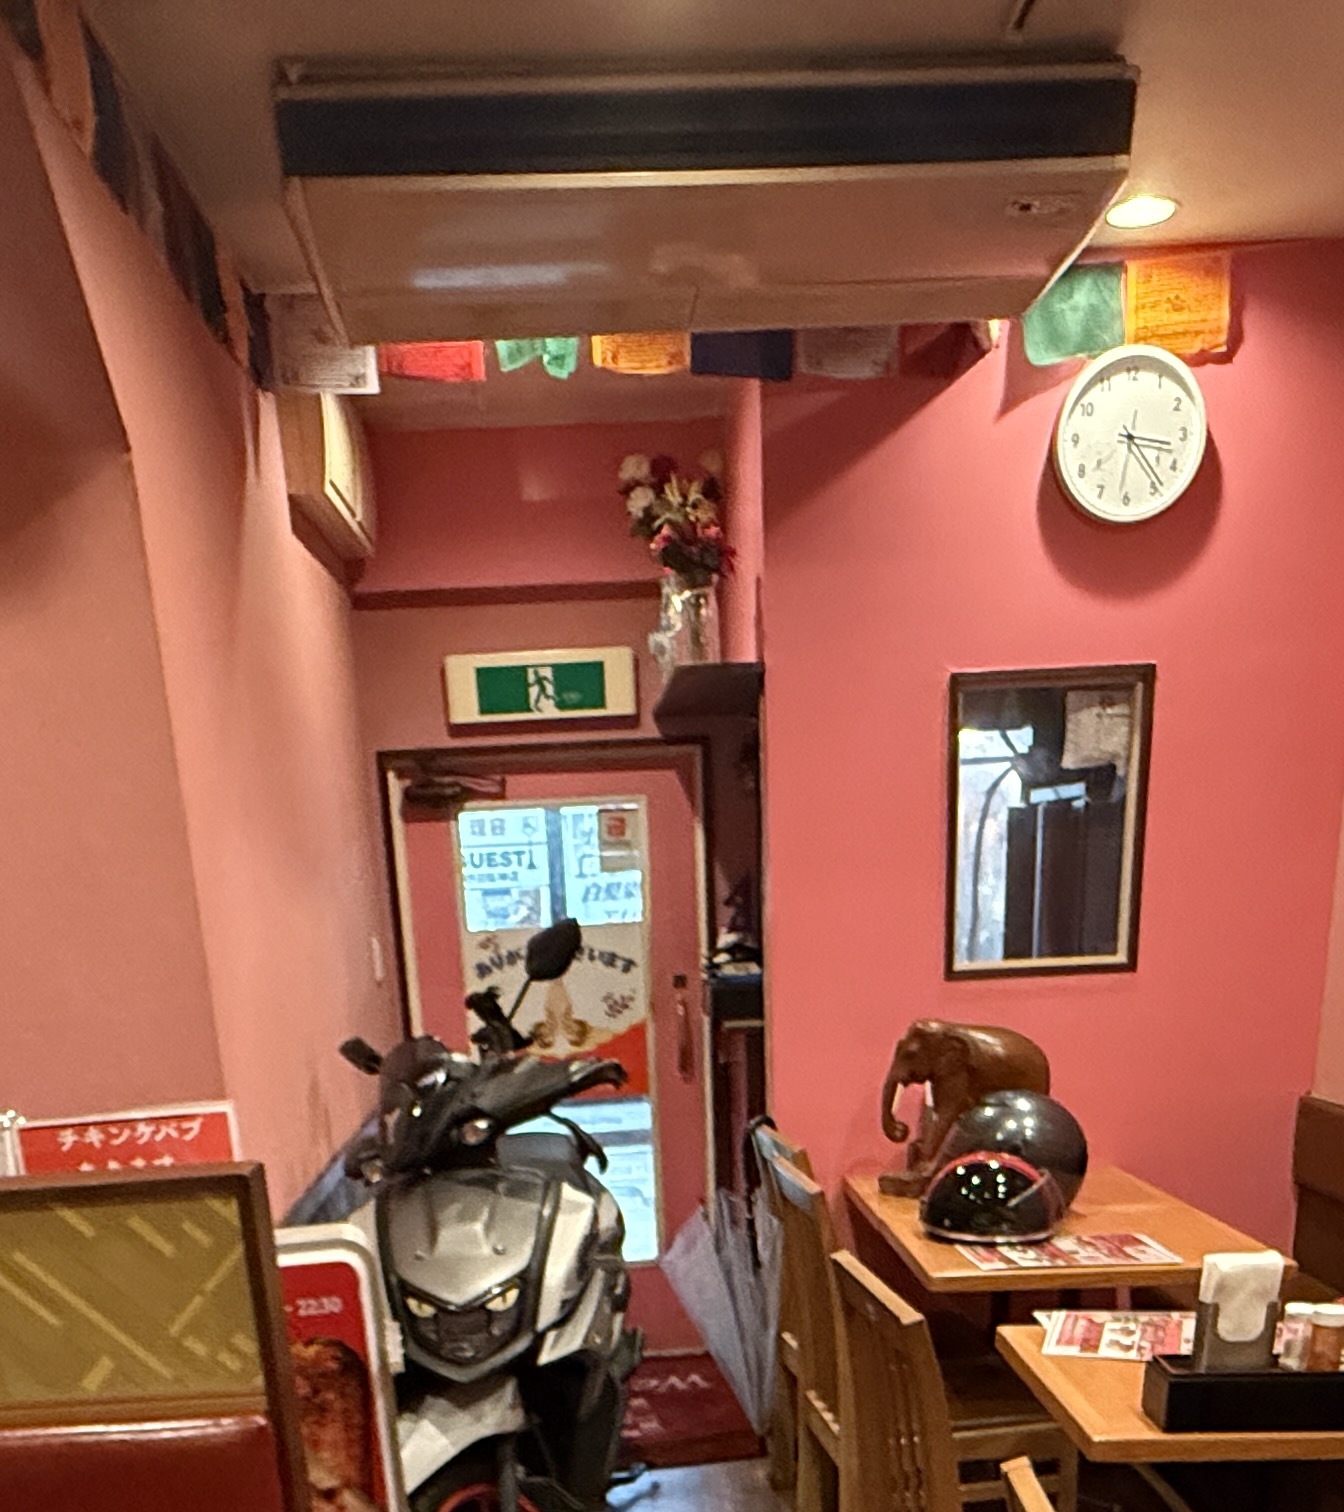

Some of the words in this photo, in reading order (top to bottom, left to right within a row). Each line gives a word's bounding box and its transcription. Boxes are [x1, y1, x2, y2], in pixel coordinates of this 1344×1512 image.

[1126, 366, 1140, 382] 12
[1158, 373, 1164, 390] 1
[1099, 376, 1112, 393] 11
[1079, 402, 1095, 417] 10
[1172, 396, 1183, 412] 2
[1071, 433, 1080, 448] 9
[1178, 426, 1188, 442] 3
[1077, 463, 1086, 479] 8
[1169, 457, 1178, 473] 4
[1096, 484, 1105, 500] 7
[1149, 480, 1158, 496] 5
[1122, 491, 1131, 507] 6
[57, 1116, 205, 1153] チキンケバブ
